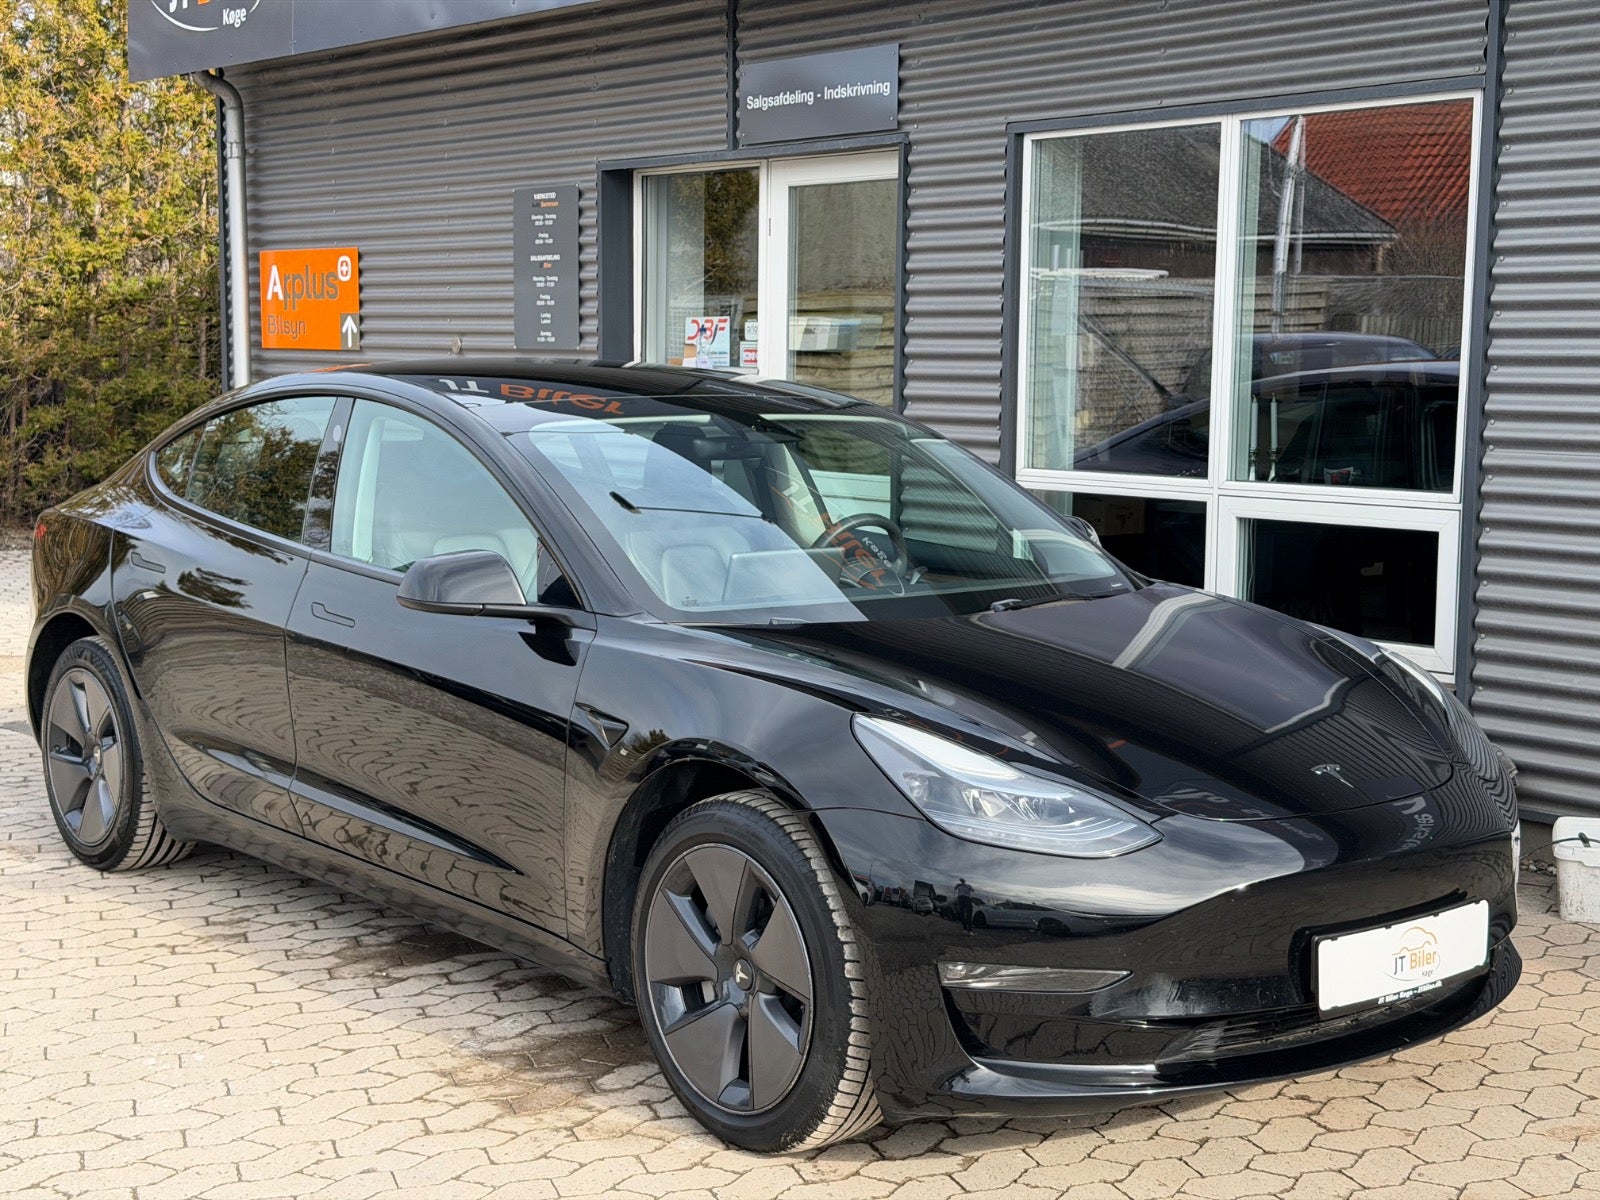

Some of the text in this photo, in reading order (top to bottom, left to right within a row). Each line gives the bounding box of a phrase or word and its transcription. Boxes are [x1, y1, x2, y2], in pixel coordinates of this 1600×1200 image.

[222, 7, 247, 28] Køge
[746, 90, 814, 111] Salgsafdeling
[824, 80, 891, 100] Indskrivning
[268, 315, 306, 339] Bilsyn
[1394, 949, 1437, 976] JT Biler
